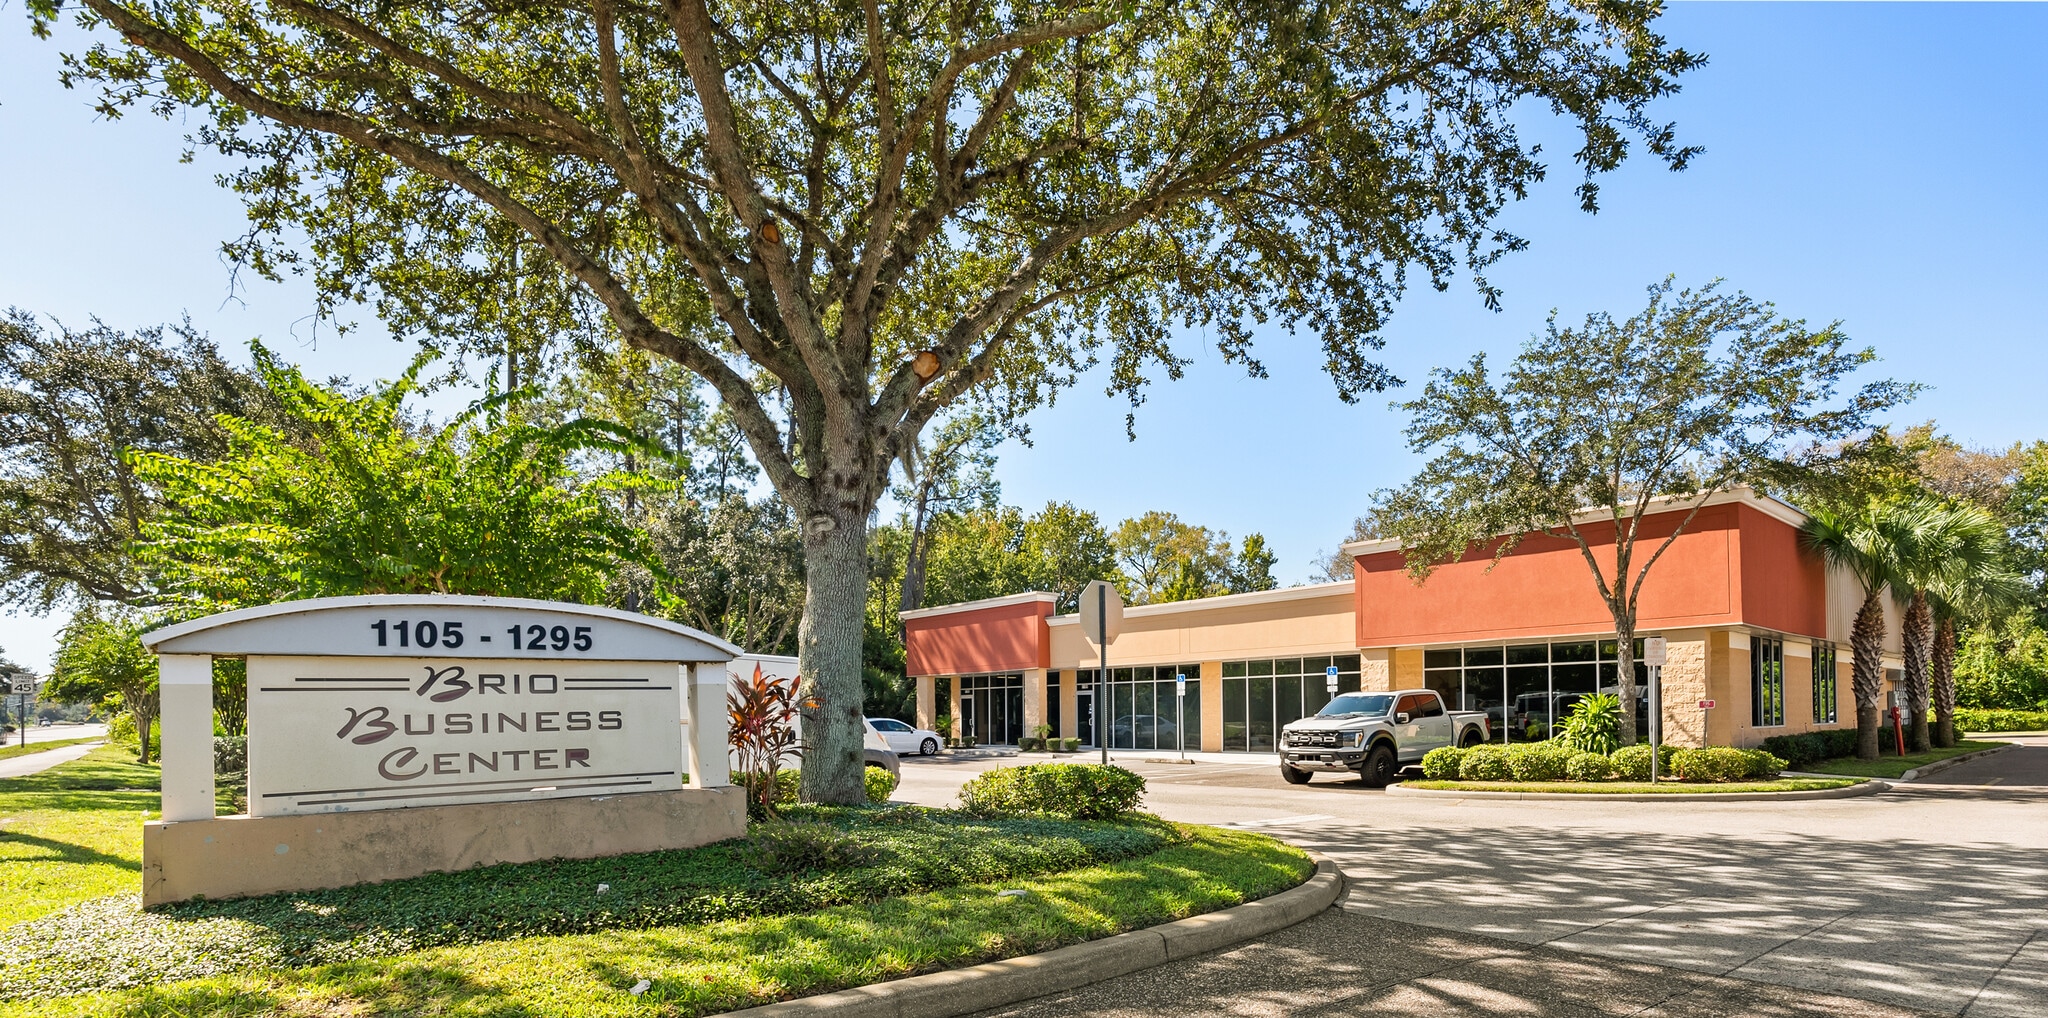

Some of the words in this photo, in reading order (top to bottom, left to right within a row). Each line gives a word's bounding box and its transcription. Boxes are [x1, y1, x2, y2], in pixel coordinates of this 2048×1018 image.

[371, 619, 464, 648] 1105
[507, 624, 593, 651] 1295
[416, 666, 557, 702] BRIO
[336, 706, 622, 745] BUSINESS
[378, 746, 591, 781] CENTER
